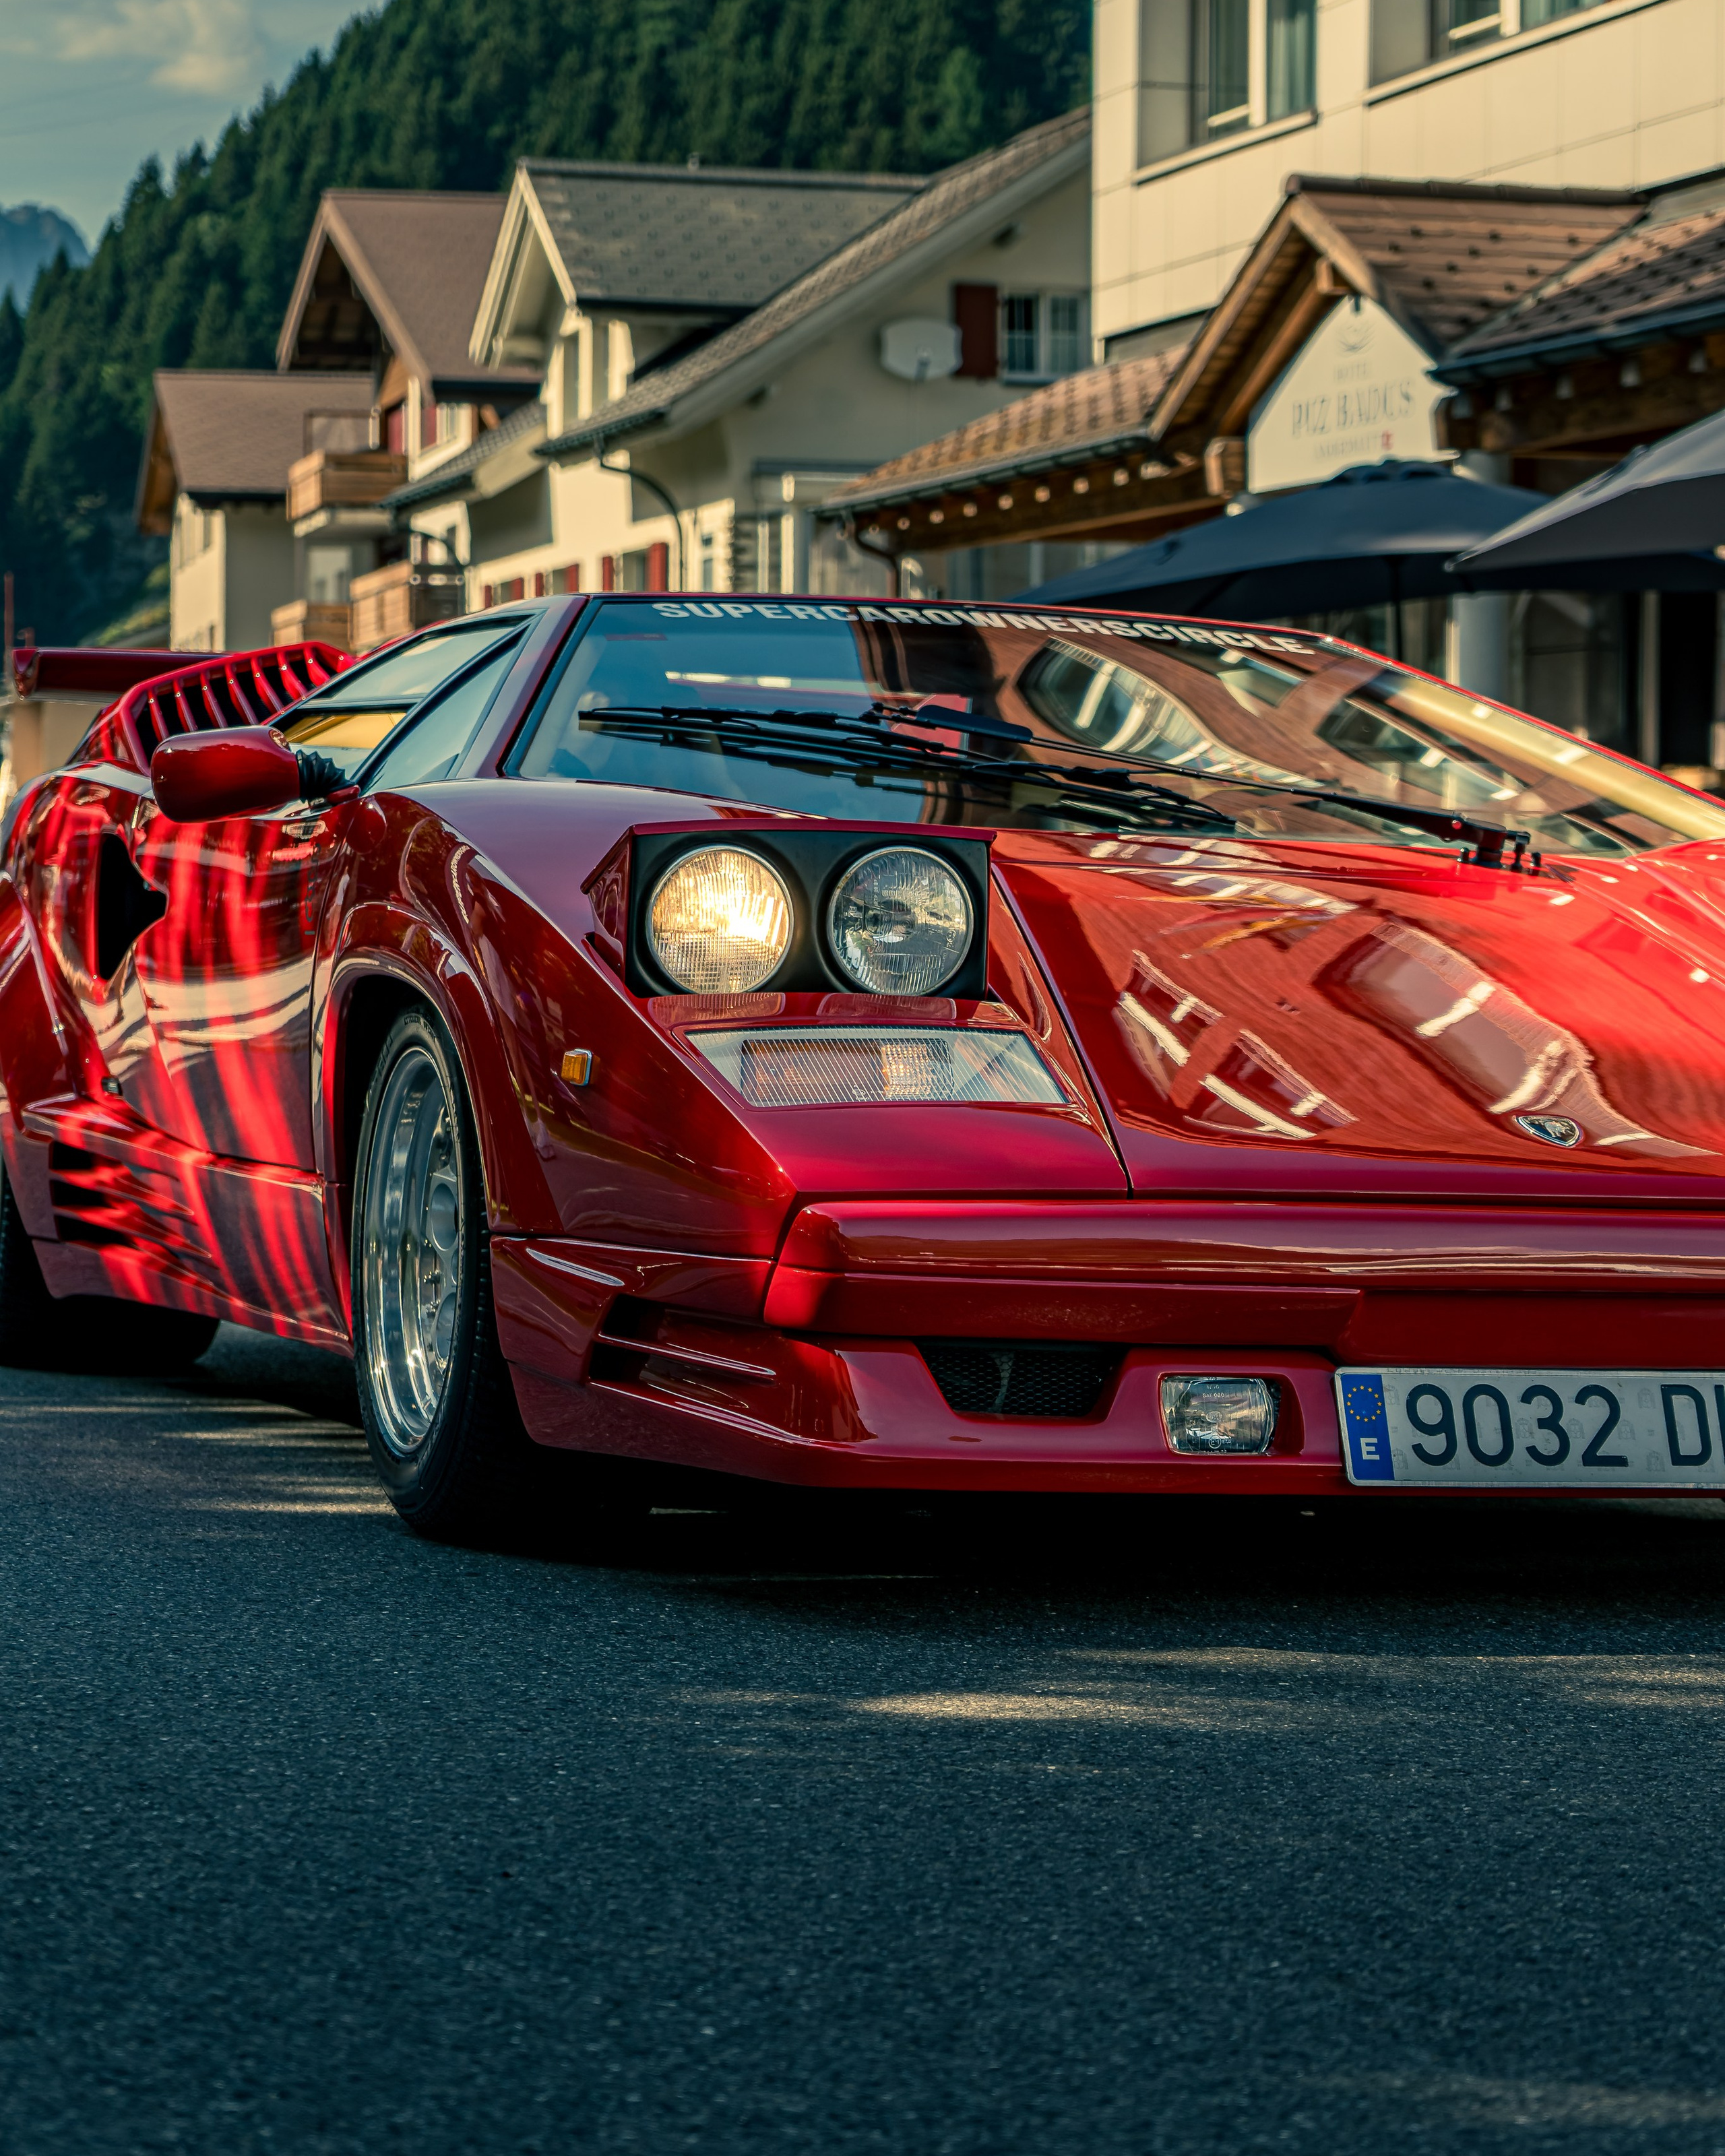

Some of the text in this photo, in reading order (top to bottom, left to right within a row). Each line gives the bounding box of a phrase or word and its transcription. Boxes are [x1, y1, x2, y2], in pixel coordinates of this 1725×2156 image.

[1292, 396, 1330, 437] PIZ
[652, 603, 1315, 655] SUPERCAROWNERSCIRCLE
[1406, 1383, 1725, 1467] 9032 D
[1360, 1437, 1380, 1460] E
